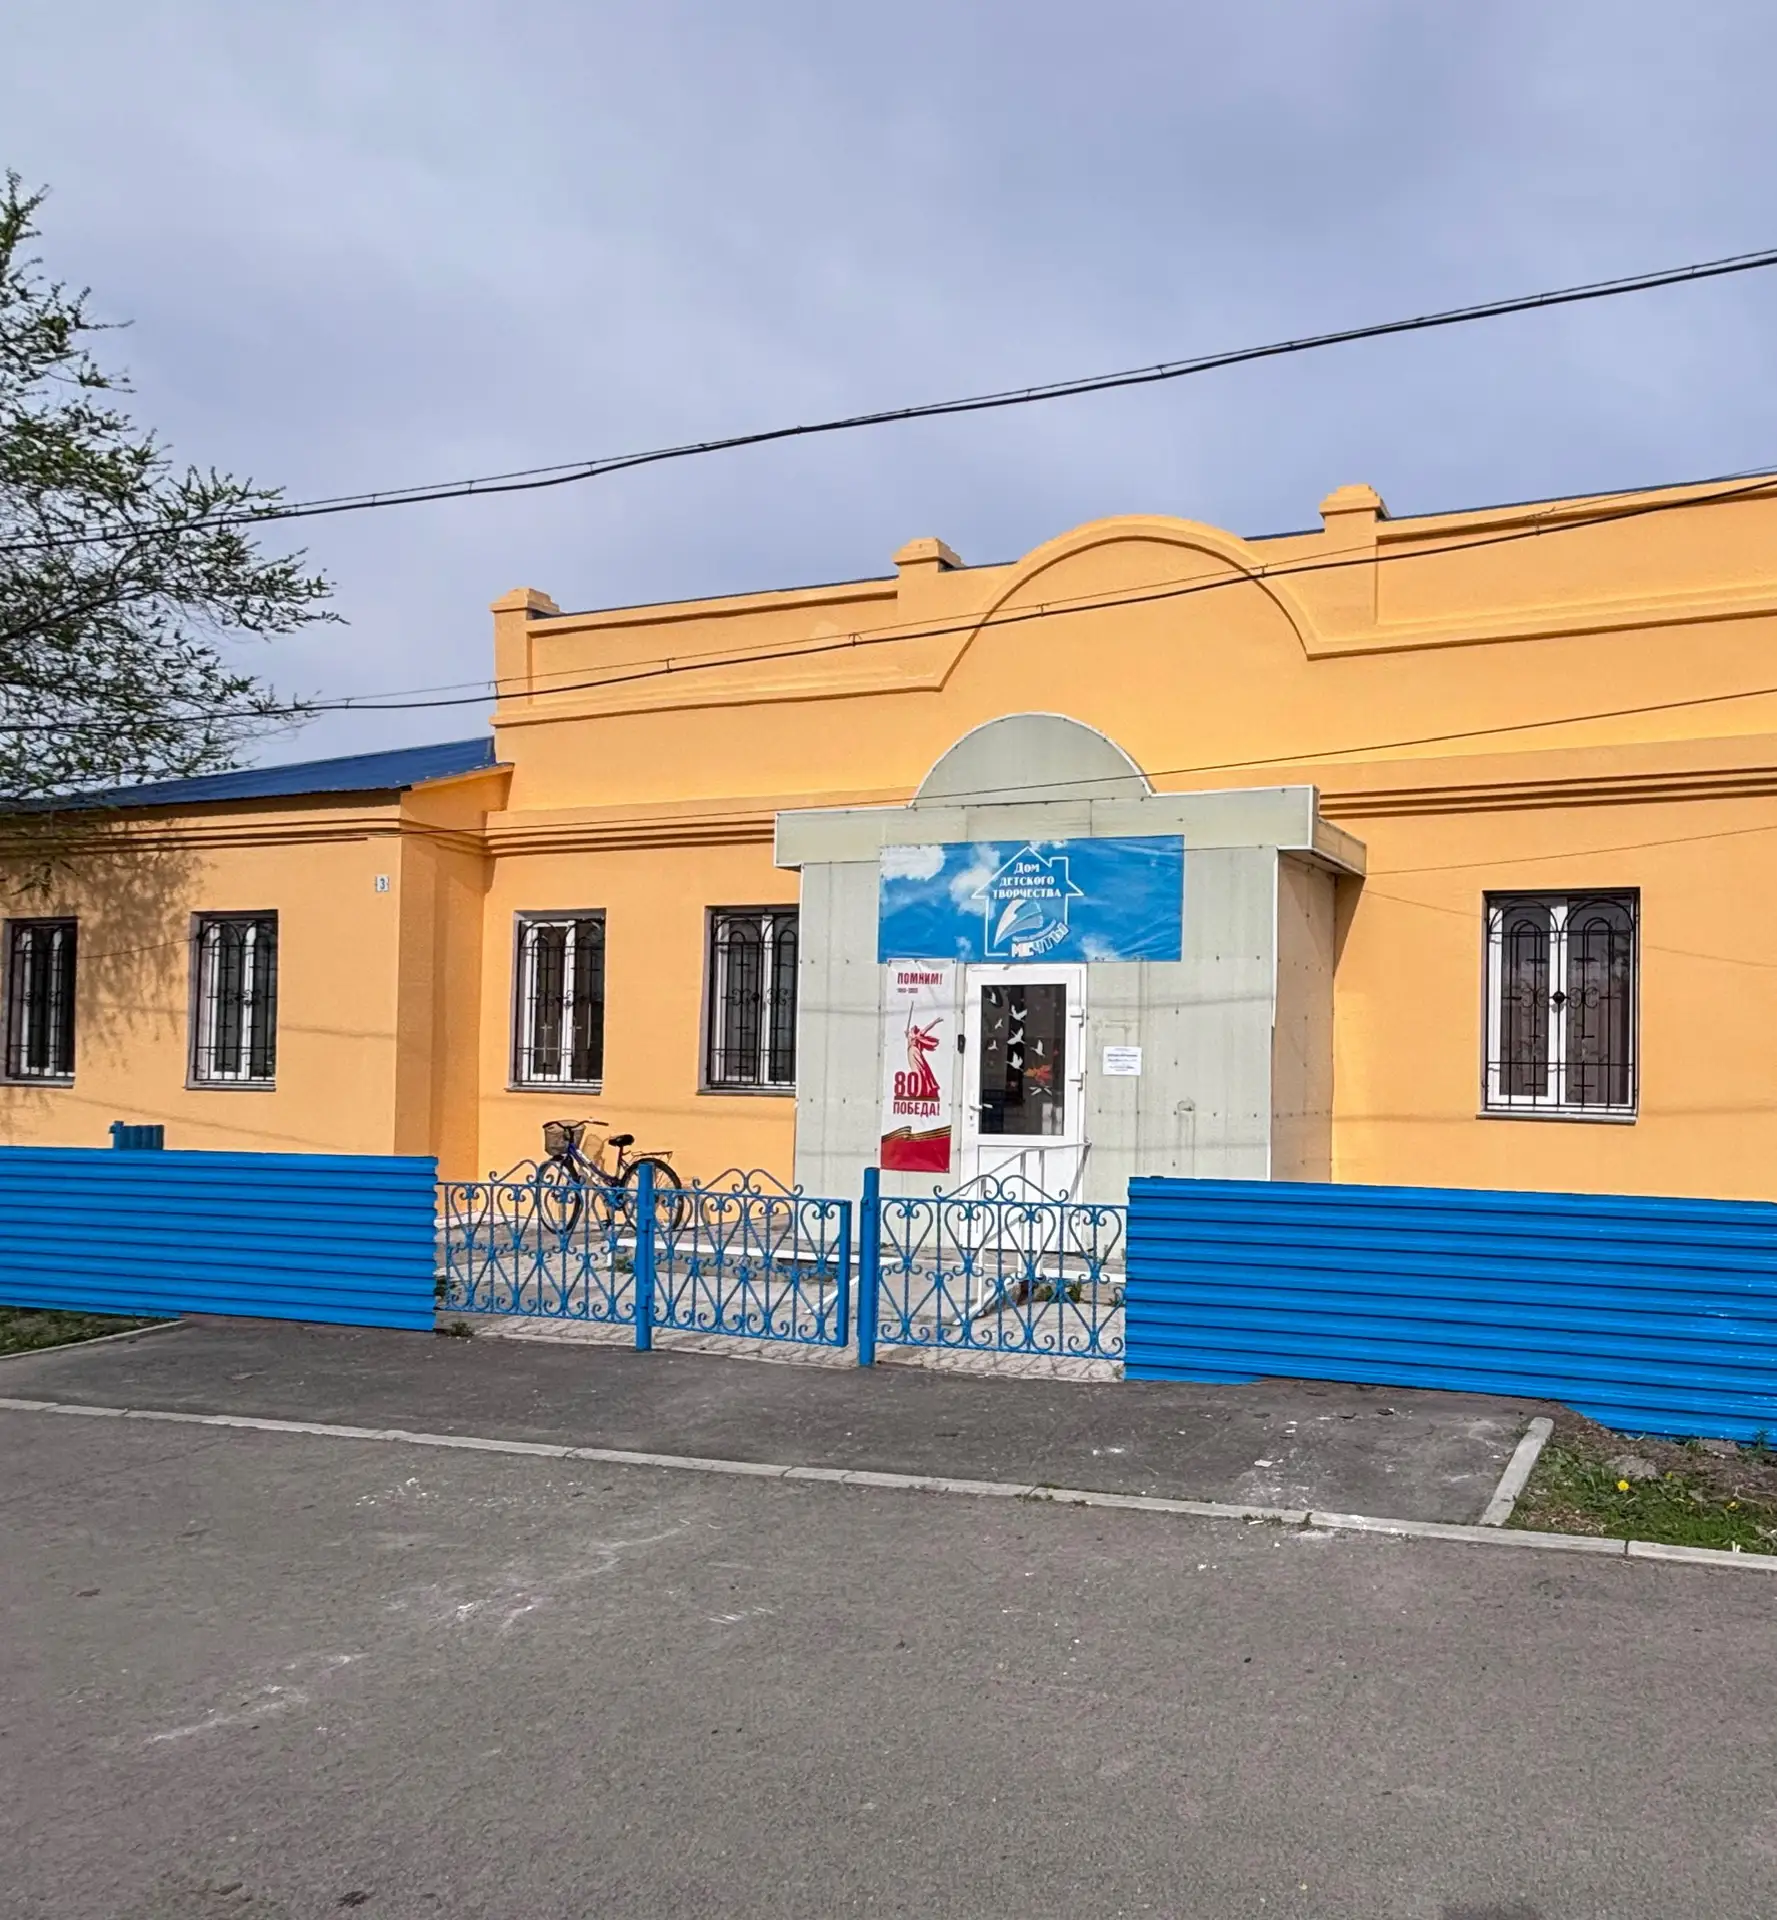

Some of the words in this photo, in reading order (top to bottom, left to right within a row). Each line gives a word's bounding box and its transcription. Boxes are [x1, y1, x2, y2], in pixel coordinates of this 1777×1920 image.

[379, 877, 386, 890] 3
[999, 876, 1055, 887] ДЕТСКОГО
[992, 888, 1062, 899] ТВОРЧЕСТВА
[897, 972, 943, 985] ПОМНИМ!
[894, 1071, 919, 1097] 80
[893, 1101, 940, 1118] ПОБЕДА!
